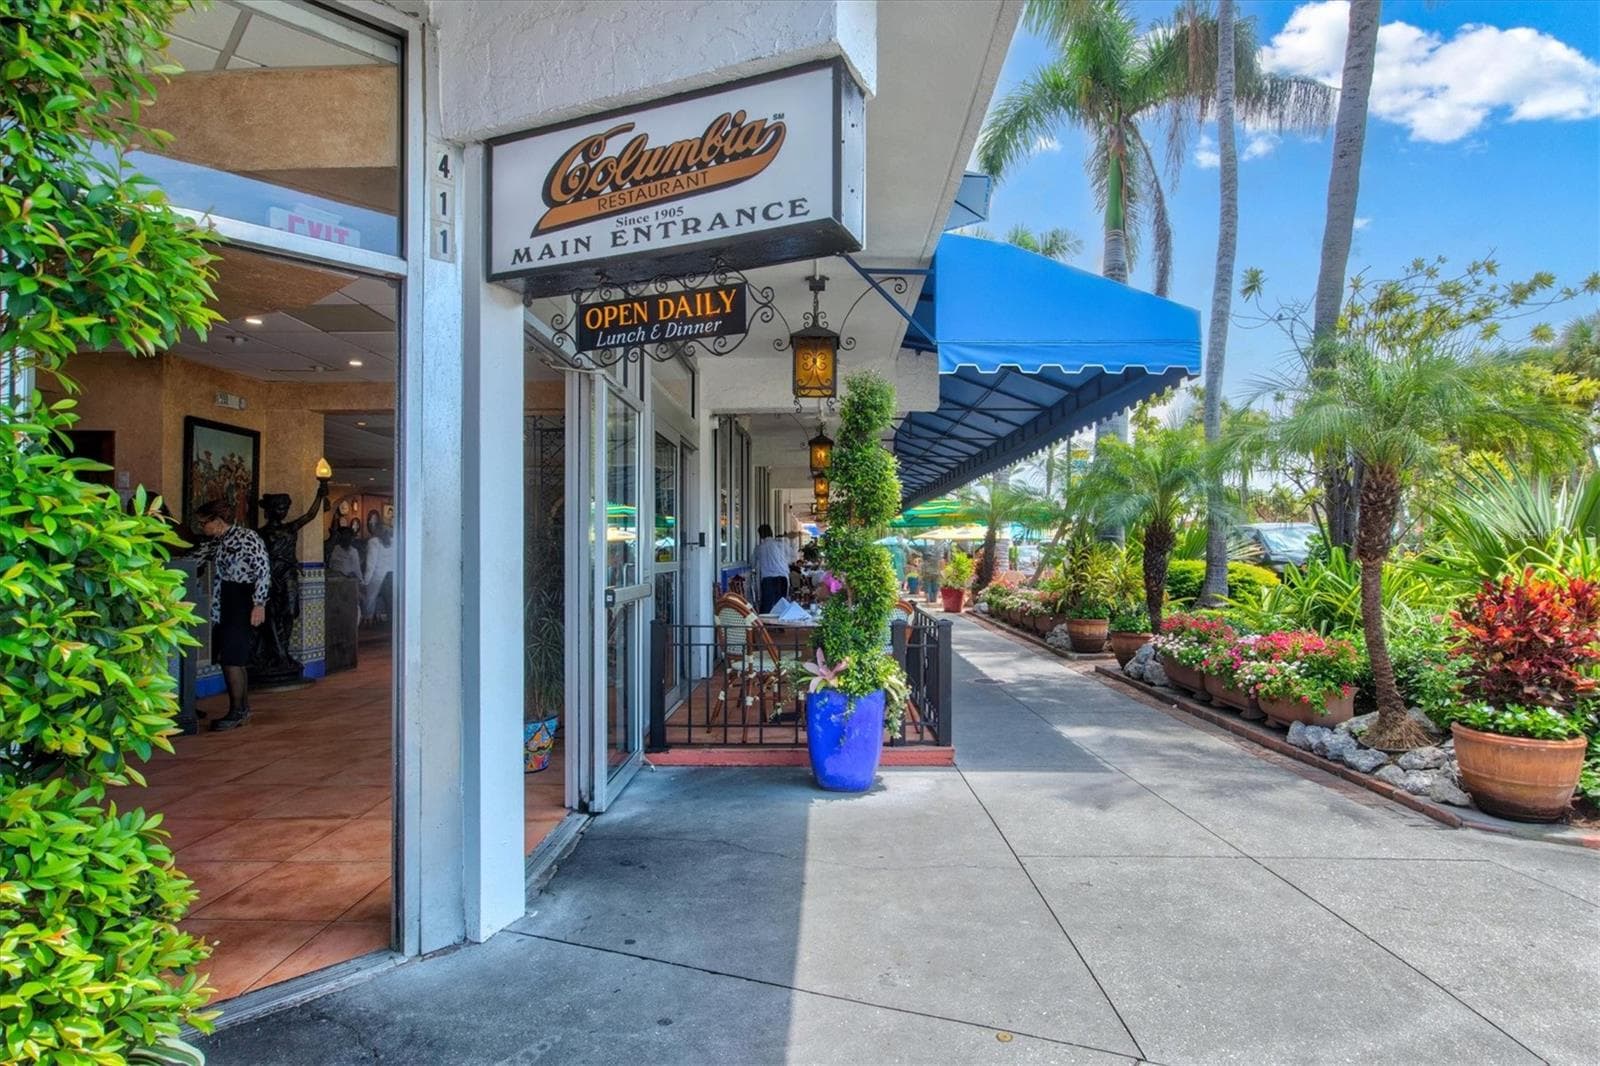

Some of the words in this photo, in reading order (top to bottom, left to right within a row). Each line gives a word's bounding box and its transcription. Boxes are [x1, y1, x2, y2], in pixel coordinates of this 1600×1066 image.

[542, 109, 770, 207] Columbia
[598, 171, 709, 211] RESTAURANT
[511, 236, 593, 265] MAIN
[610, 197, 811, 248] ENTRANCE
[616, 214, 650, 229] Since
[654, 206, 685, 221] 1905
[585, 301, 648, 330] OPEN
[658, 289, 737, 320] DAILY
[596, 326, 645, 347] Lunch
[650, 324, 661, 340] &
[665, 320, 723, 339] Dinner
